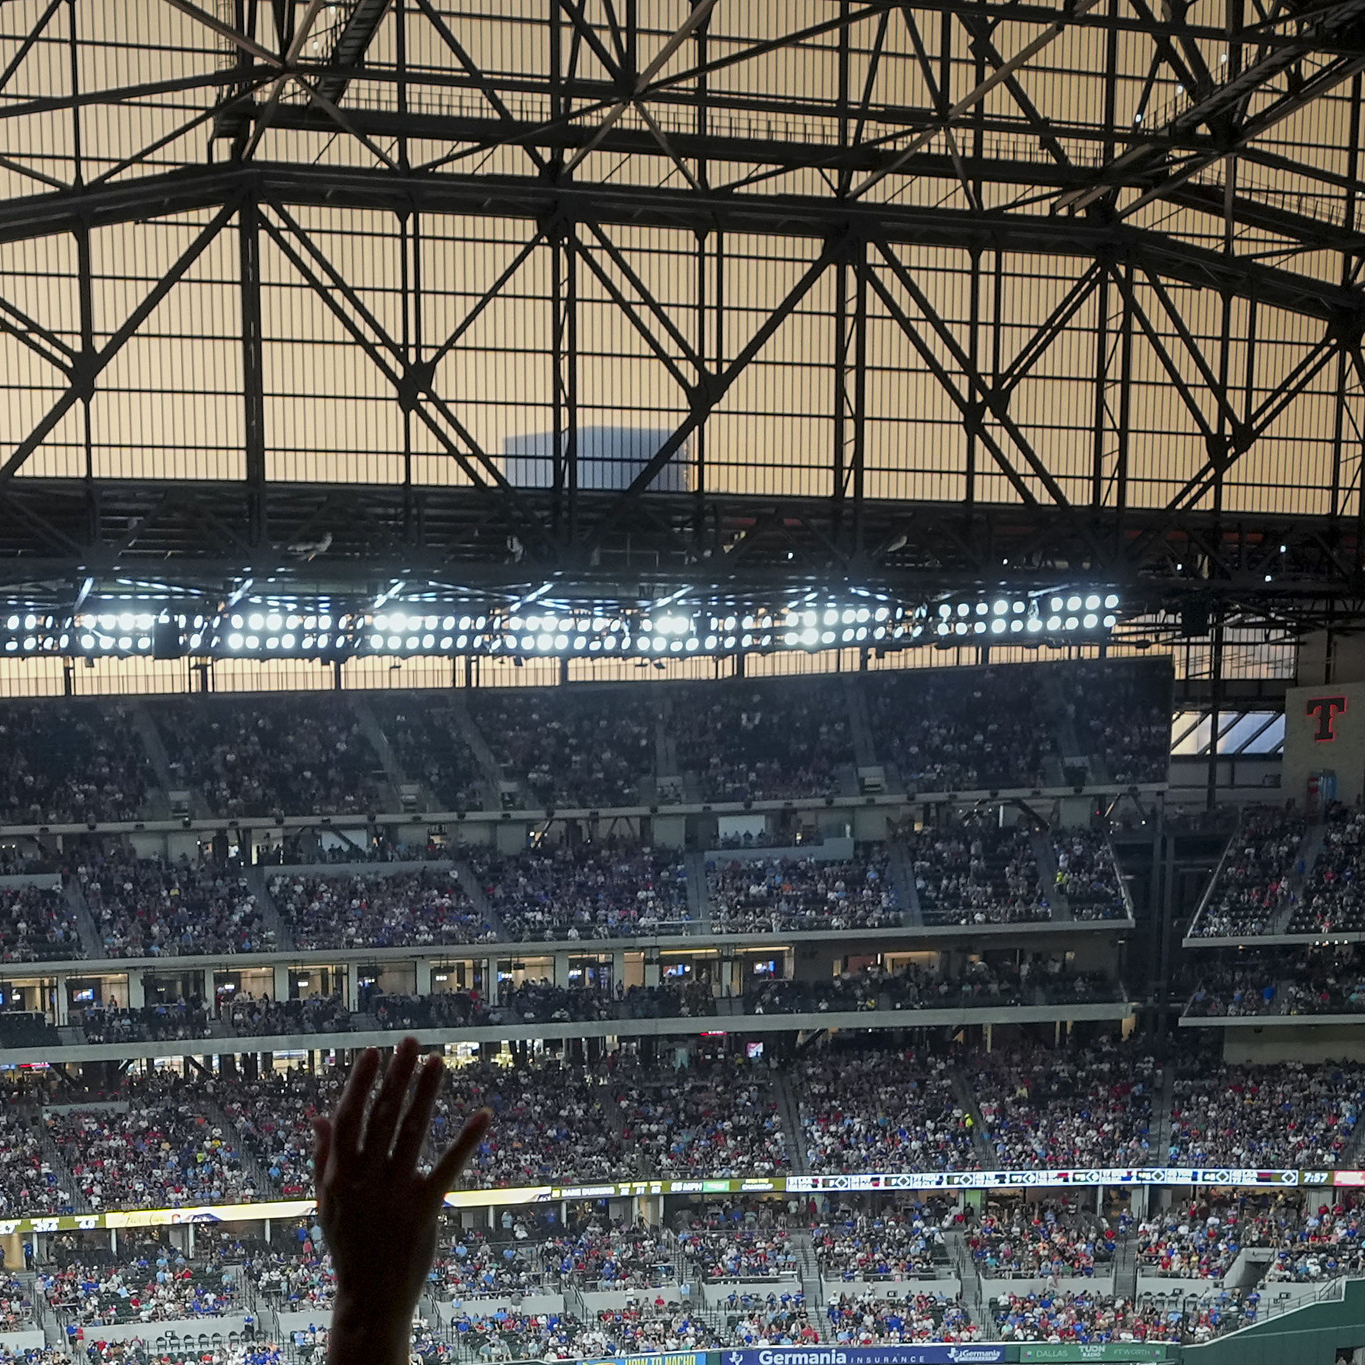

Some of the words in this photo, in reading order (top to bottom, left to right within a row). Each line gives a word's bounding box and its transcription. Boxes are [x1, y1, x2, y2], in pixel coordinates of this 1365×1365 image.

[1306, 696, 1348, 742] T
[683, 1182, 703, 1191] MPH
[758, 1349, 847, 1365] Germania
[850, 1355, 925, 1364] INSURANCE
[962, 1349, 1001, 1358] Germania
